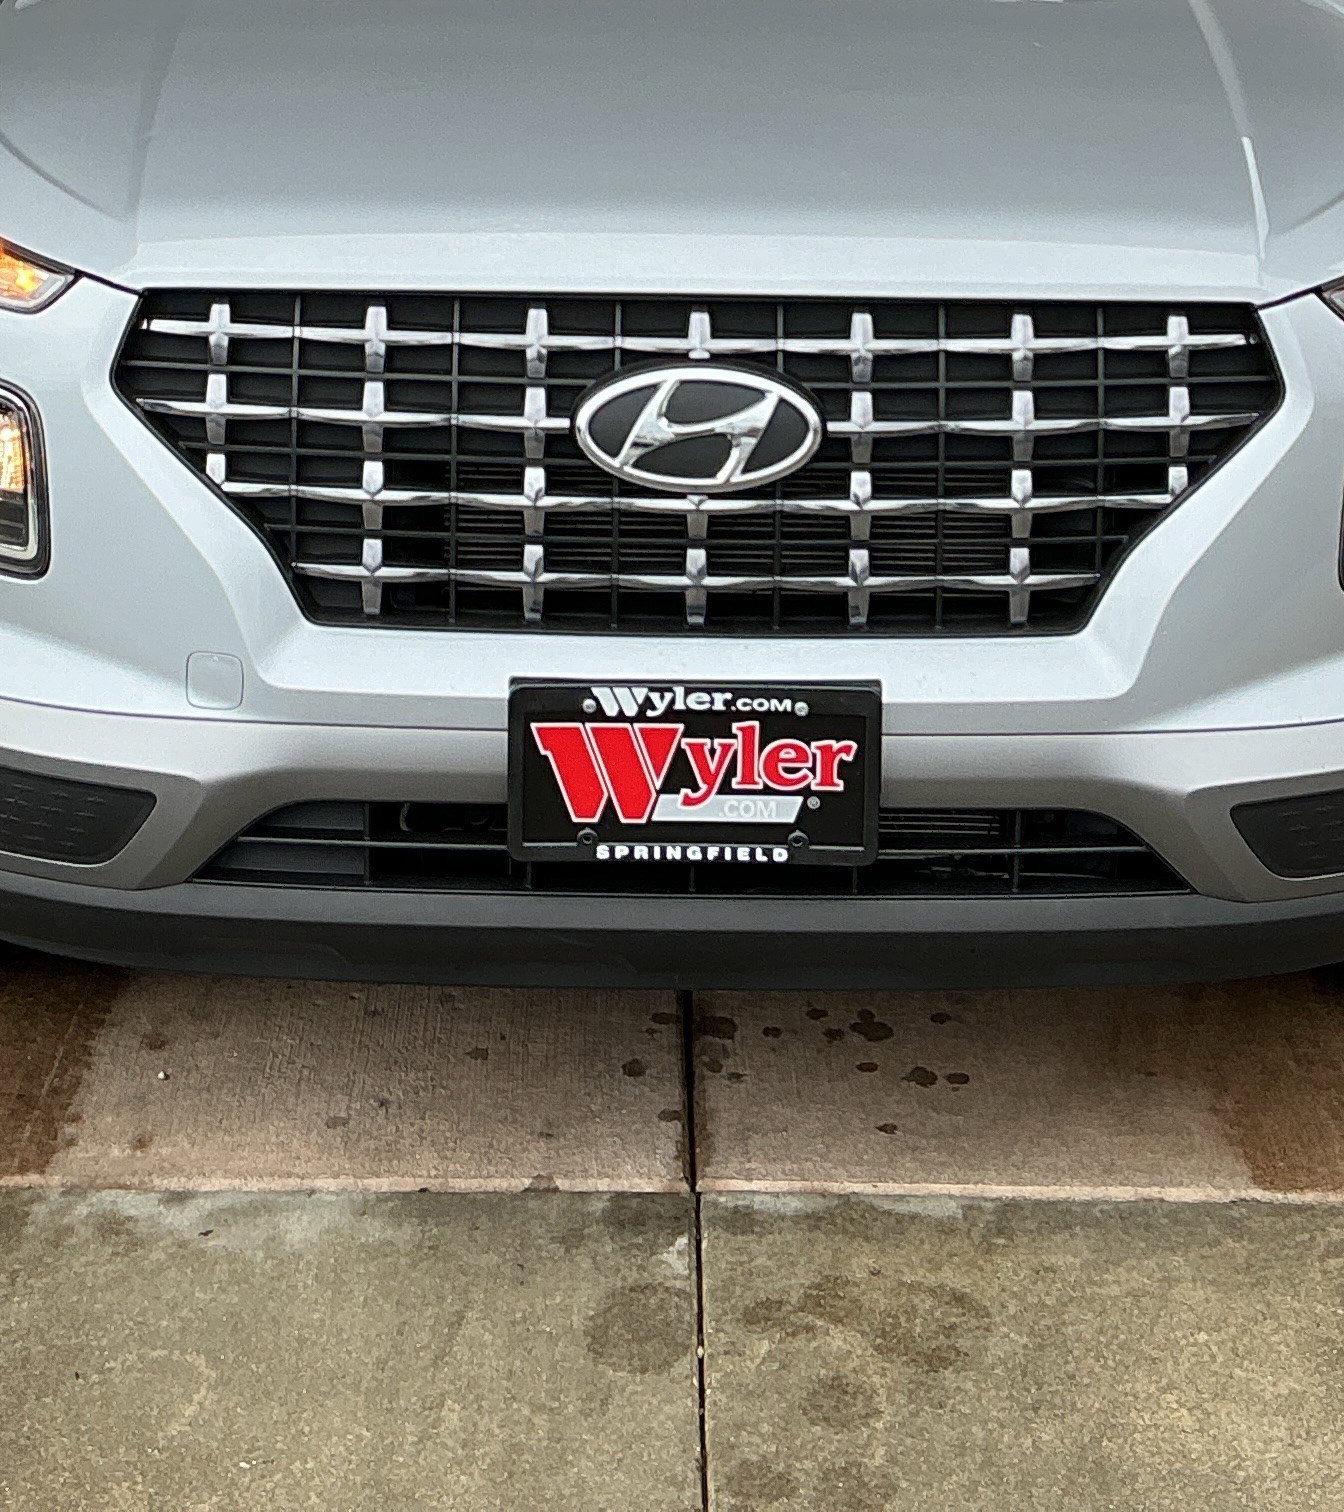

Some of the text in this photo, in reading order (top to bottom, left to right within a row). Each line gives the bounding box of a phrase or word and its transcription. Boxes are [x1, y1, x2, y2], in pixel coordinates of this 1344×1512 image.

[530, 720, 858, 824] Wyler
[718, 799, 778, 820] .COM
[595, 844, 790, 863] SPRINGFIELD
